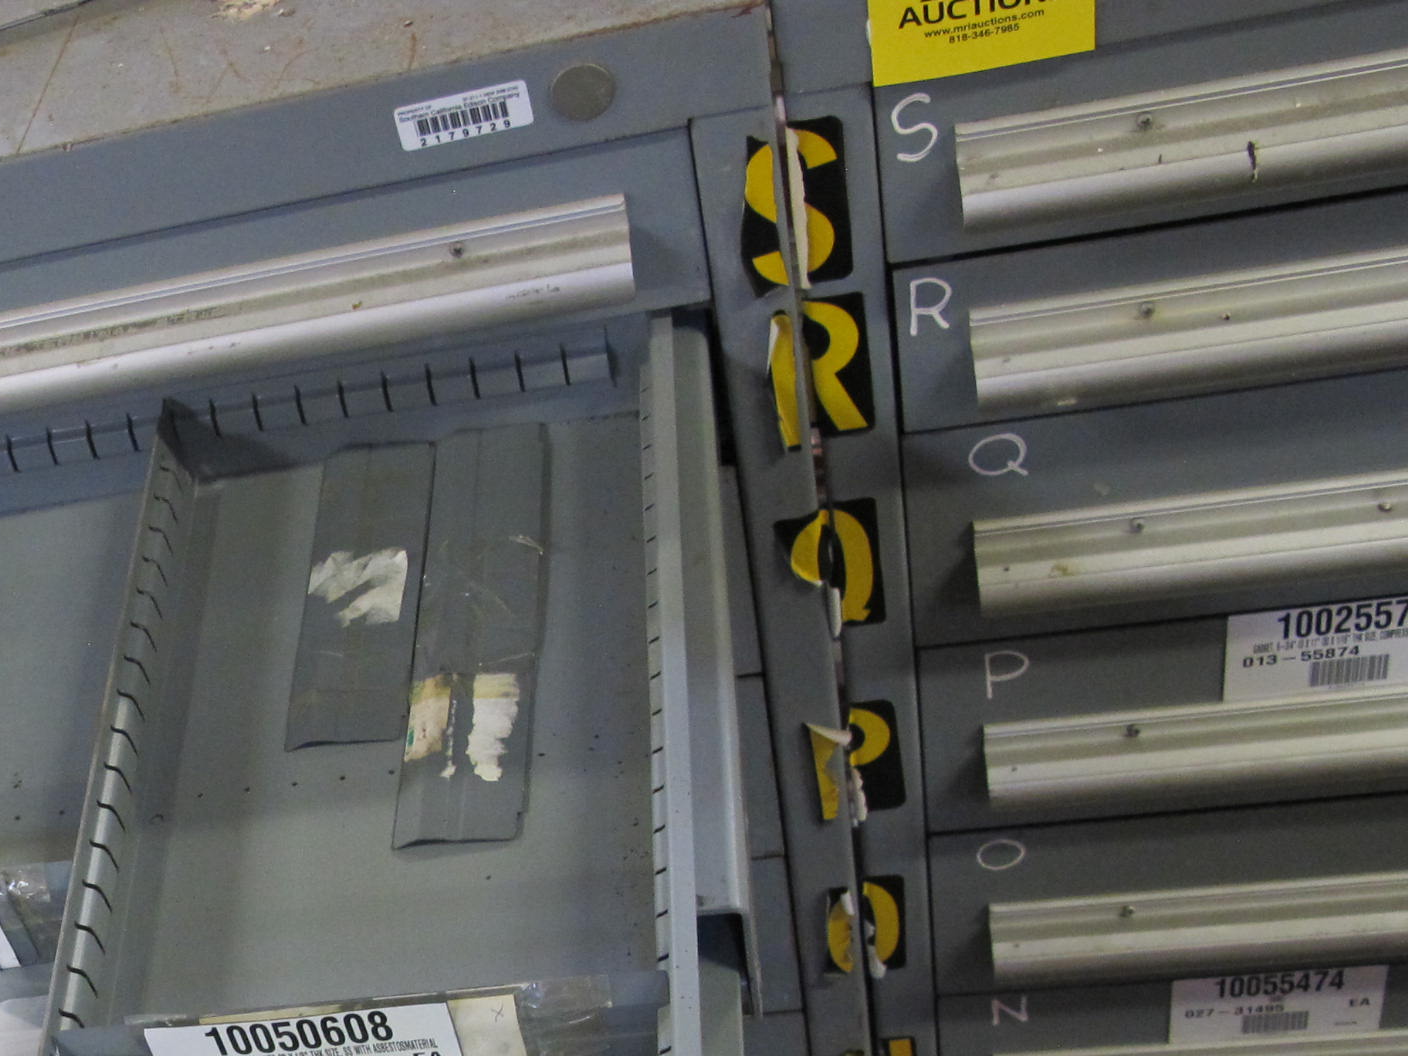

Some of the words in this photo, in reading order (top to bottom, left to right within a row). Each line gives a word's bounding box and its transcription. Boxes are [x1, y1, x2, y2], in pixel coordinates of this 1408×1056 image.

[924, 9, 1045, 38] www.mriauctions.com
[949, 23, 1019, 44] 818-346-7985
[892, 92, 938, 162] S
[910, 277, 952, 336] R
[968, 432, 1029, 476] Q
[985, 650, 1030, 699] P
[1216, 969, 1344, 999] 10055474
[205, 1010, 393, 1056] 10050608
[354, 1045, 372, 1055] WITH
